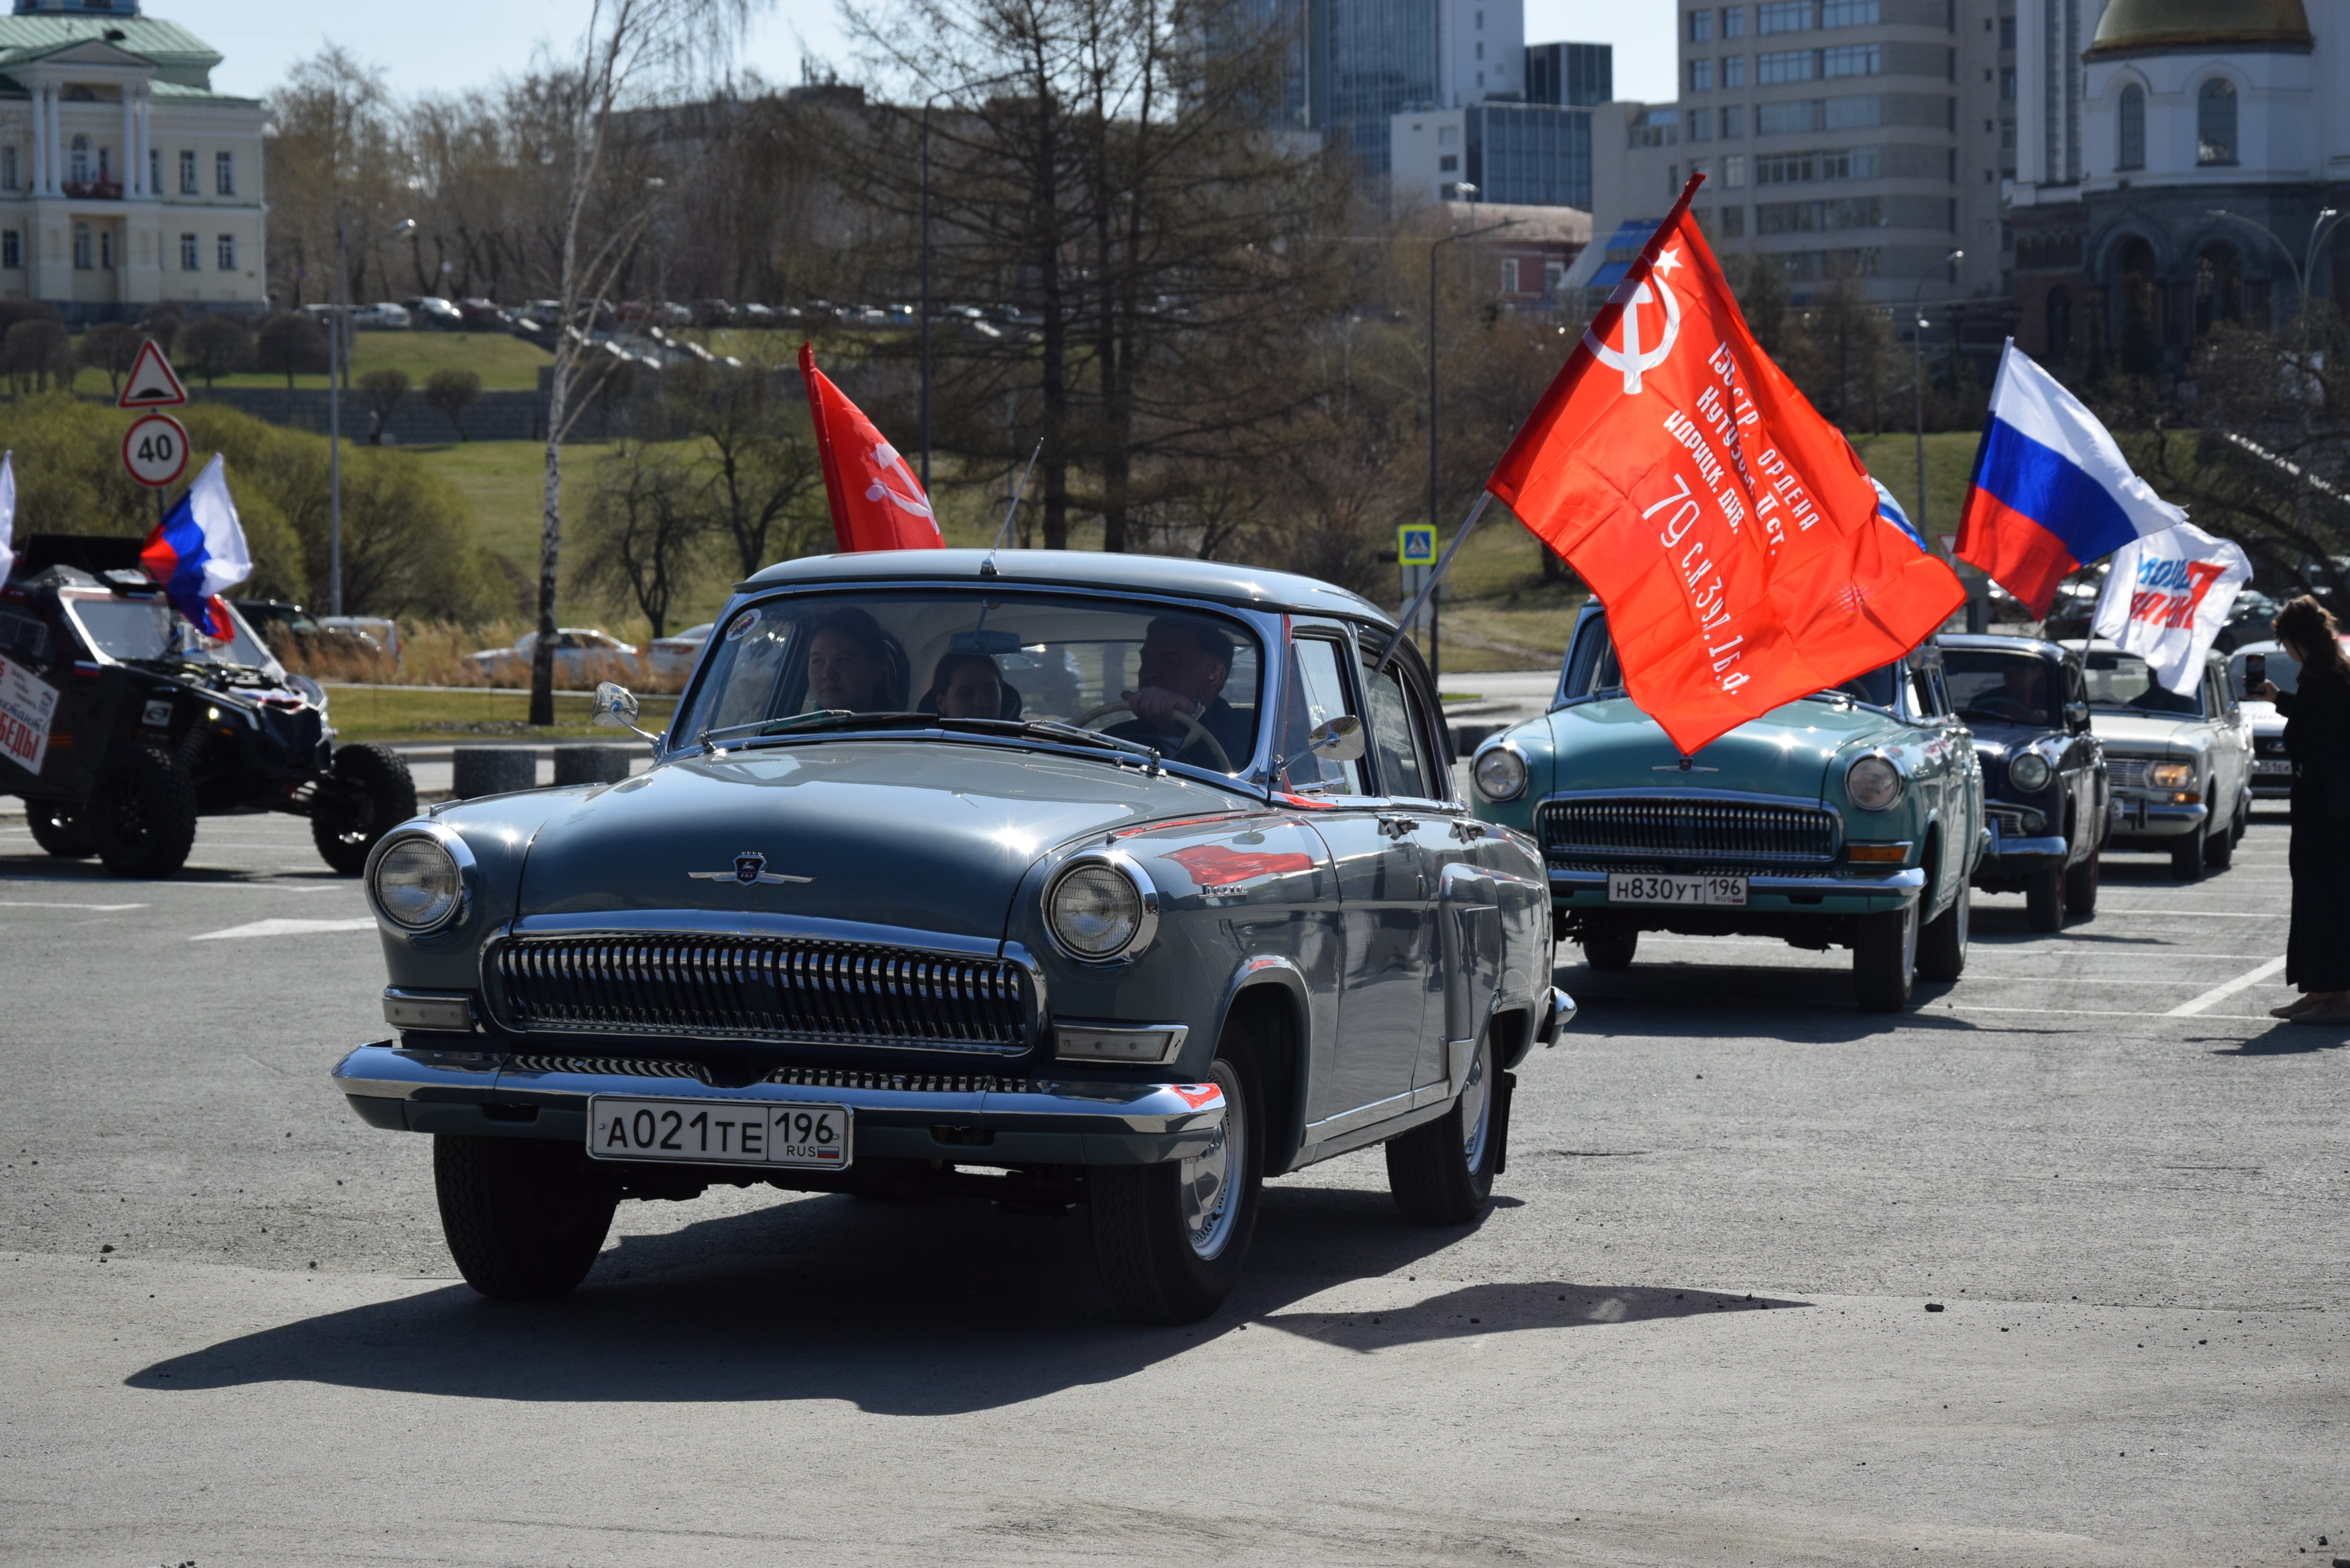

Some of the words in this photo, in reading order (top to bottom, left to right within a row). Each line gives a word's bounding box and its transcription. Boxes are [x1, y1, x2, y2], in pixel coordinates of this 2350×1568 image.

[137, 434, 171, 463] 40
[1642, 473, 1700, 548] 79
[1708, 879, 1741, 895] 196
[606, 1109, 763, 1154] А021ТЕ
[774, 1112, 834, 1144] 196
[787, 1145, 816, 1157] RUS
